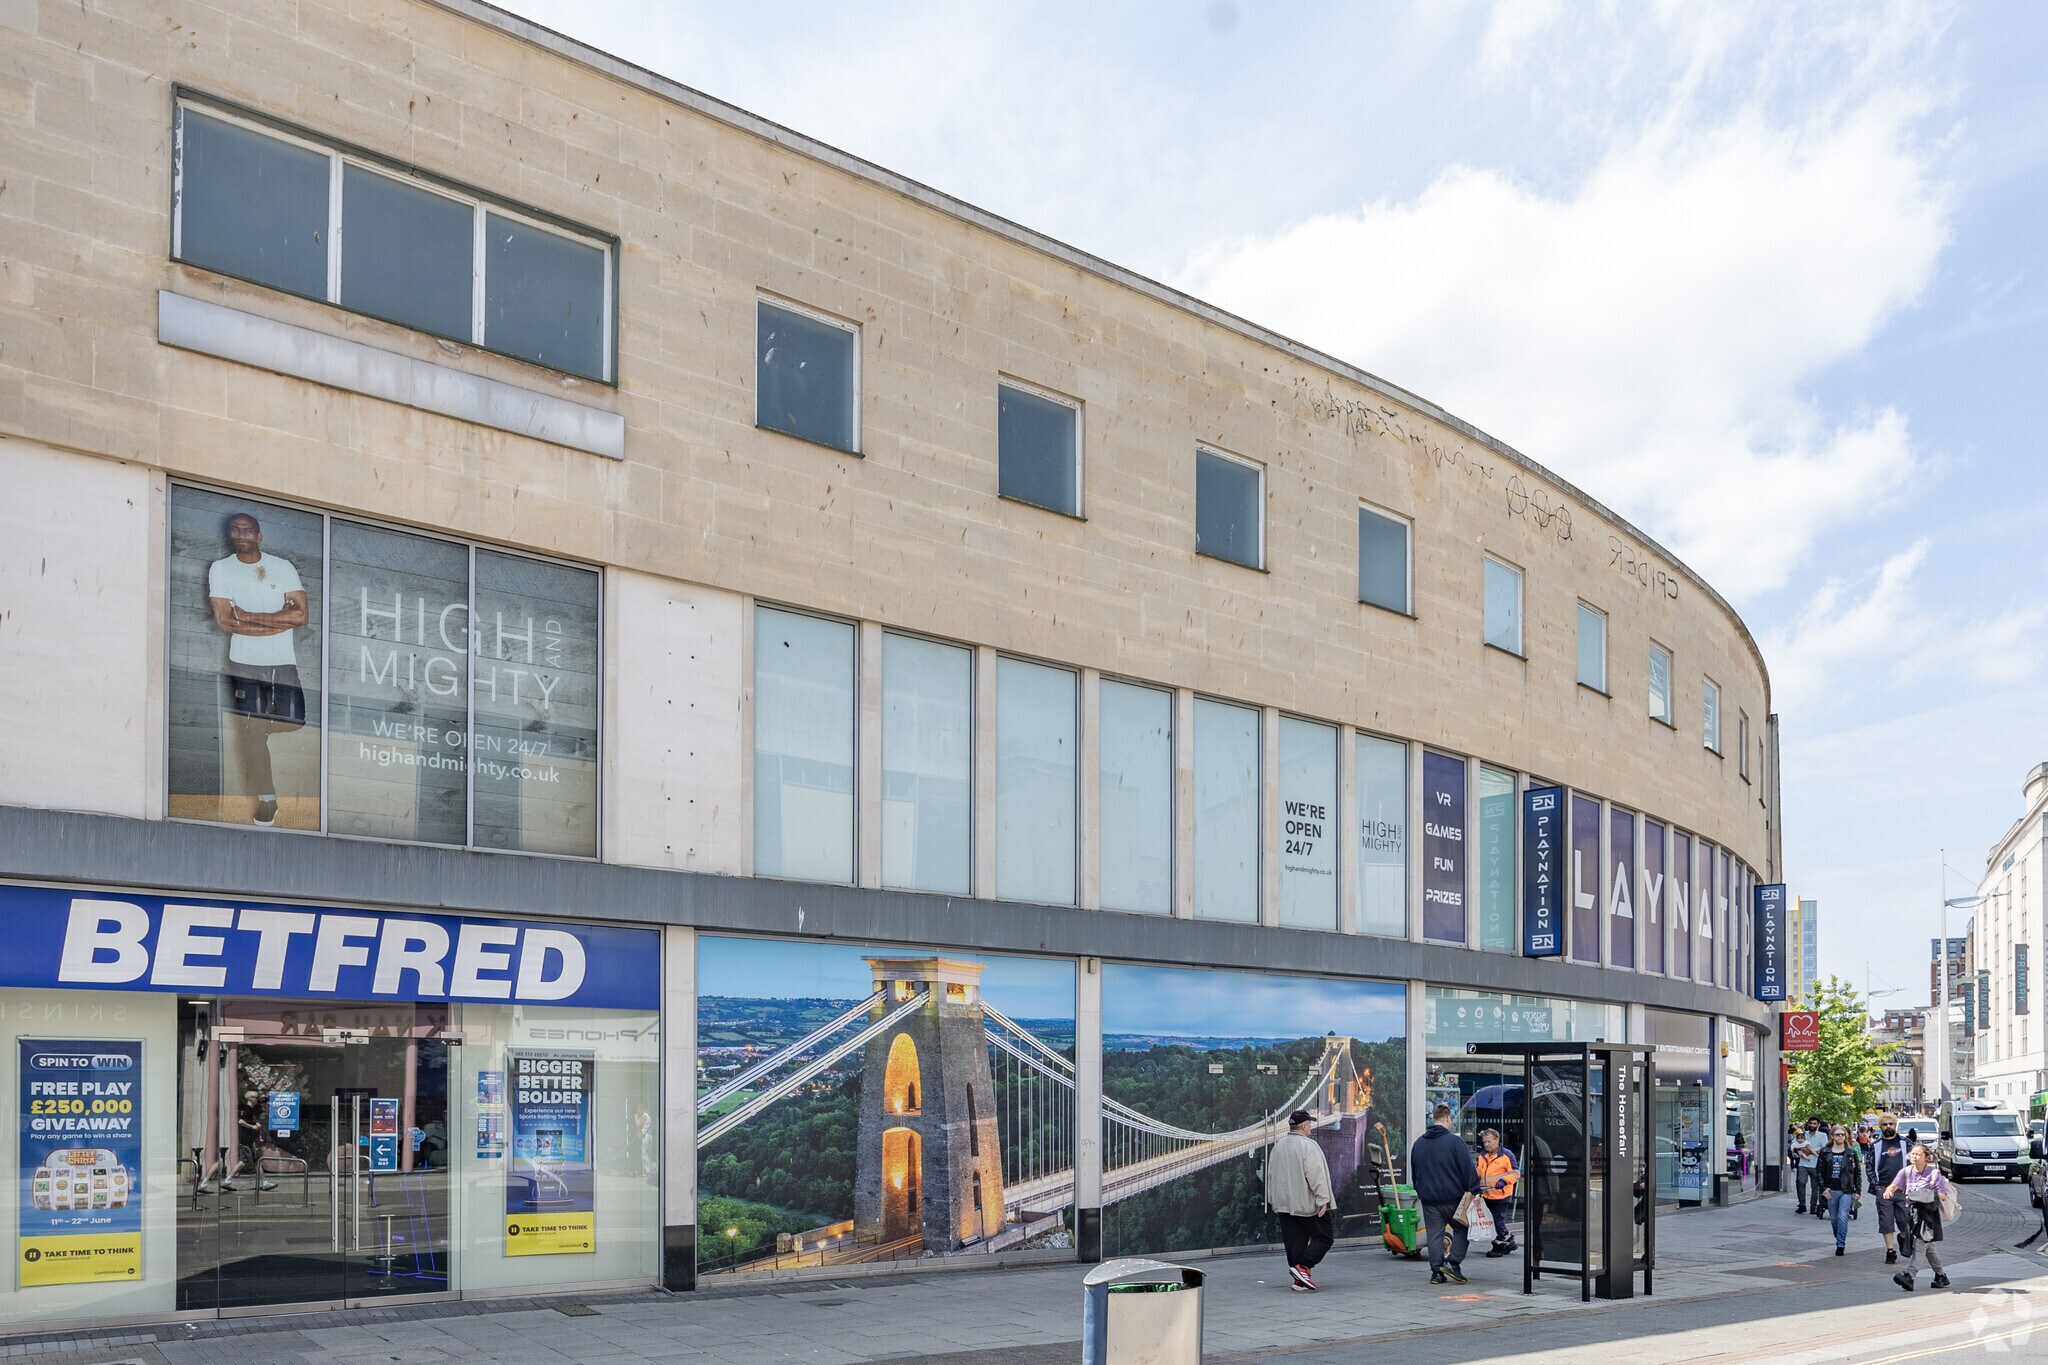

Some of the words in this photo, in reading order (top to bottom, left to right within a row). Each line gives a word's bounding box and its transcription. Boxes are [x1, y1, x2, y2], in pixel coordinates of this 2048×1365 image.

[361, 586, 533, 664] HIGH
[545, 619, 562, 669] AND
[361, 644, 561, 711] MIGHTY
[372, 719, 439, 745] WE'RE
[507, 738, 548, 758] 24/7
[359, 742, 560, 784] highandmihty.co.uk
[1435, 791, 1452, 807] VR
[1285, 800, 1326, 820] WE'RE
[1285, 820, 1322, 838] OPEN
[1362, 819, 1397, 840] HIGH
[1425, 822, 1462, 841] GAMES
[1285, 839, 1313, 856] 24/7
[1362, 836, 1402, 853] MIGHTY
[1434, 856, 1454, 872] FUN
[1536, 816, 1550, 929] PLAYNATION
[1425, 889, 1462, 906] PRIZES
[57, 897, 587, 1000] BETFRED
[1765, 904, 1776, 982] PLAYNATION
[2017, 953, 2026, 1003] PRIMARK
[1660, 1044, 1695, 1053] ENTERTAINMENT
[1695, 1047, 1710, 1055] CENTRE
[39, 1057, 69, 1067] SPIN
[71, 1057, 89, 1067] TO
[97, 1057, 128, 1067] WIN
[519, 1059, 583, 1074] BIGGER
[519, 1075, 582, 1090] BETTER
[1618, 1065, 1627, 1091] The
[30, 1082, 79, 1096] FREE
[81, 1082, 132, 1096] PLAY
[519, 1091, 582, 1104] BOLDER
[30, 1099, 132, 1116] £250,000
[30, 1117, 132, 1131] GIVEAWAY
[1618, 1094, 1627, 1158] Horsefair
[67, 1157, 96, 1165] CHINA
[68, 1150, 96, 1158] LITTLE
[71, 1217, 89, 1225] 22nd
[44, 1250, 68, 1258] TAKE
